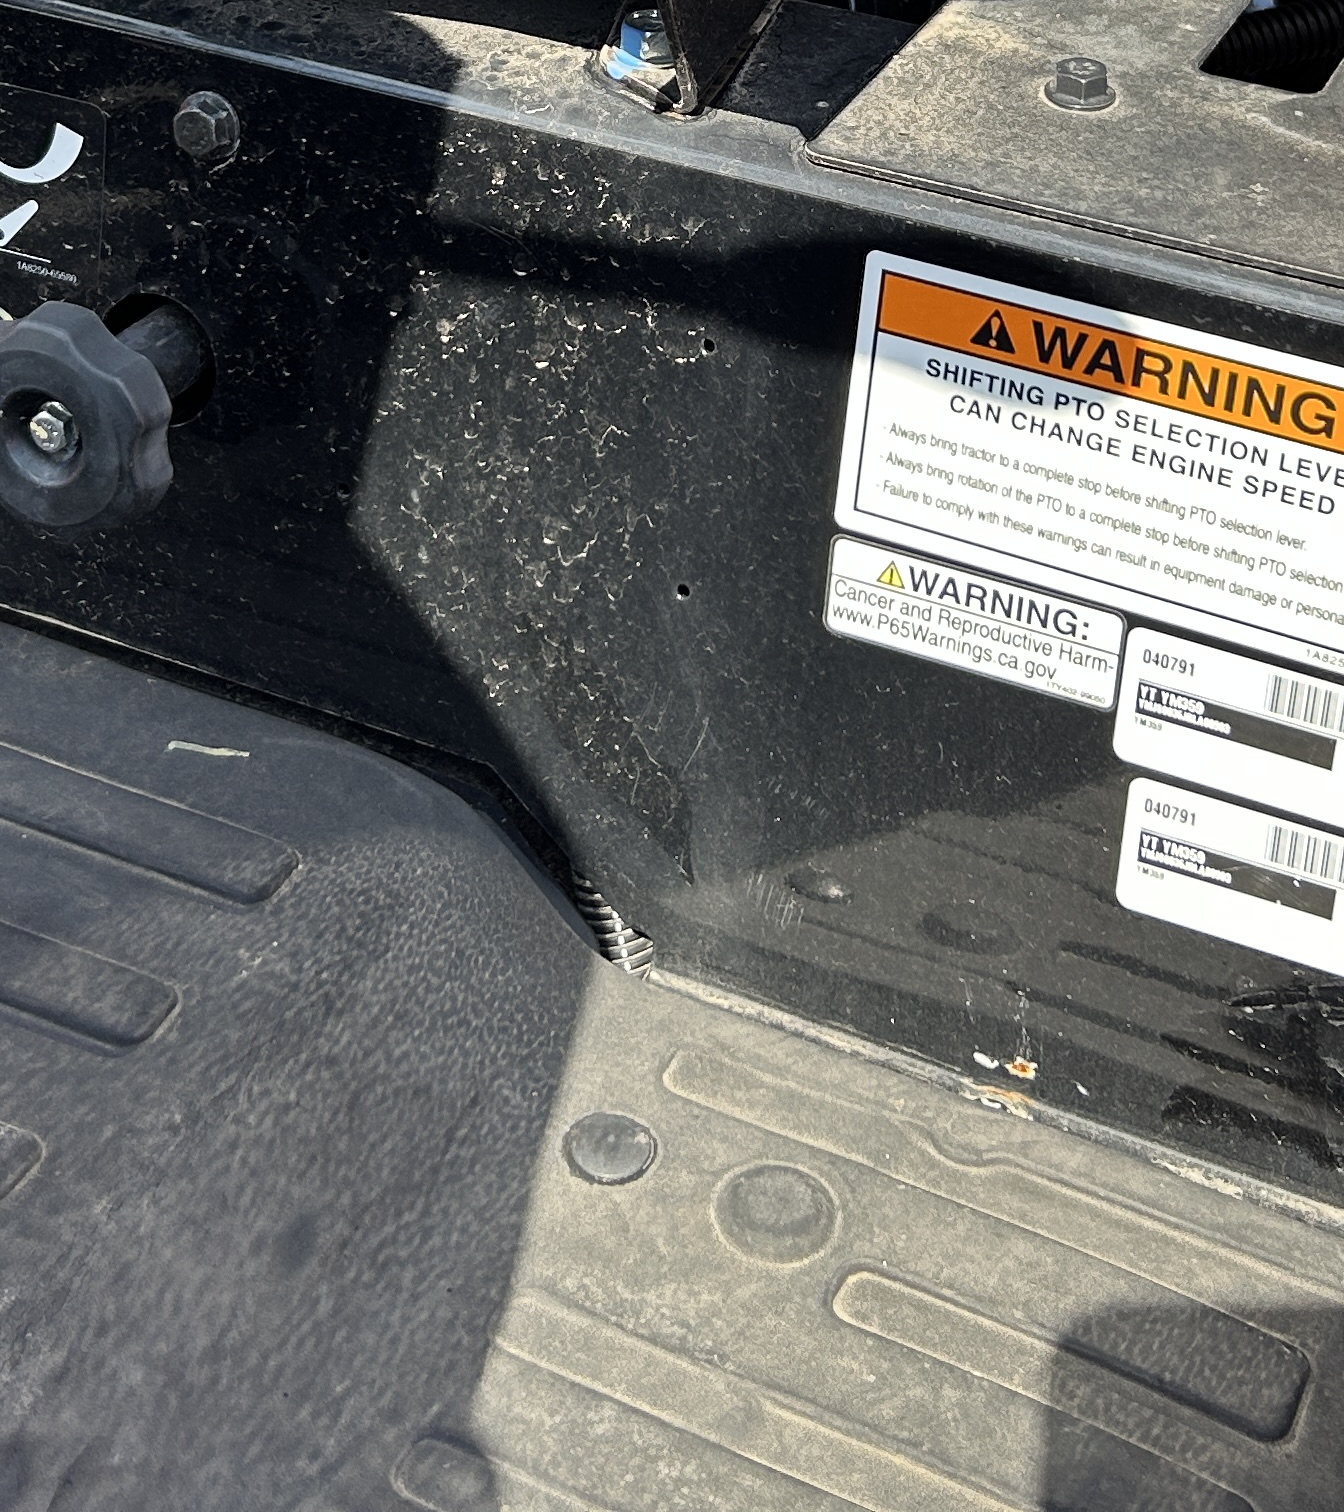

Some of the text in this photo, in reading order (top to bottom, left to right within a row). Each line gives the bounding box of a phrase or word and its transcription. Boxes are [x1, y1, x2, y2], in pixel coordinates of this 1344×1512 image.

[924, 356, 1046, 408] SHIFTING
[1052, 391, 1105, 424] PTO
[1114, 407, 1270, 469] SELECTION
[1029, 318, 1340, 441] WARNING
[888, 421, 1309, 552] Always bring tractor to a complete stop before shifting PTO selection lever.
[948, 392, 1337, 518] CAN CHANGE ENGINE SPEED
[882, 478, 919, 502] Failure
[921, 490, 933, 506] to
[934, 493, 975, 522] comply
[976, 506, 1000, 526] with
[1001, 513, 1034, 536] these
[1036, 524, 1089, 555] warnings
[1090, 541, 1112, 558] can
[1114, 545, 1148, 568] result
[1149, 555, 1161, 572] in
[1162, 560, 1226, 594] equipment
[1227, 578, 1278, 609] damage
[1279, 596, 1294, 611] or
[885, 449, 924, 477] Always
[925, 461, 955, 486] bring
[956, 470, 999, 495] rotation
[1000, 482, 1013, 499] of
[1014, 486, 1033, 505] the
[1035, 492, 1062, 513] PTO
[1064, 501, 1077, 517] to
[1077, 507, 1087, 520] a
[1088, 508, 1142, 539] complete
[1144, 524, 1170, 547] stop
[1172, 531, 1211, 556] before
[1211, 542, 1256, 572] shifting
[1257, 555, 1287, 577] PTO
[1288, 564, 1344, 594] selection
[830, 600, 1057, 682] www.P65Warnings.ca.gov
[832, 577, 896, 612] Cancer
[898, 596, 933, 623] and
[936, 607, 1054, 661] Reproductive
[905, 564, 1091, 641] WARNING:
[1142, 647, 1196, 678] 040791
[1143, 796, 1197, 827] 040791
